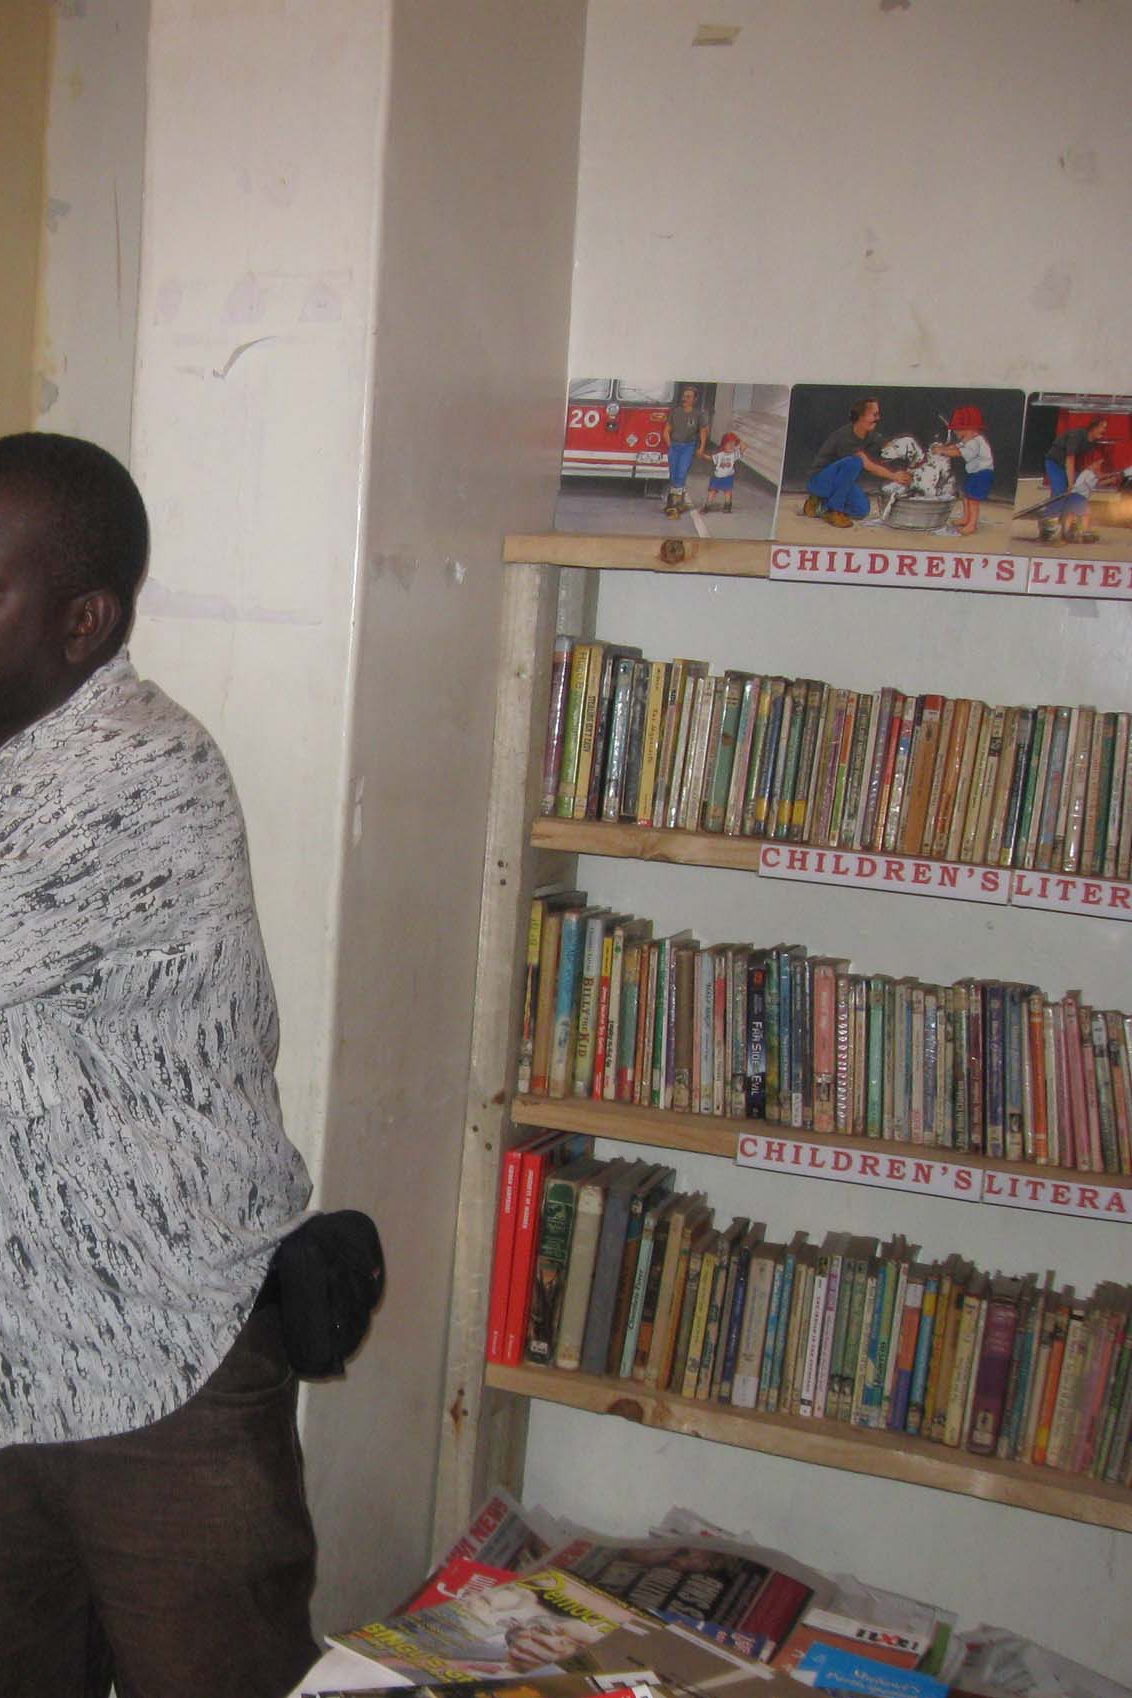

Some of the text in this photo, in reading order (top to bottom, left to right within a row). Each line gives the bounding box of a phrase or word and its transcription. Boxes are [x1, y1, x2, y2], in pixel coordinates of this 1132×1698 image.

[569, 409, 600, 429] 20
[771, 549, 1132, 588] CHILDREN'S LITE
[761, 847, 1132, 910] CHILDREN'S LITER
[580, 977, 595, 1016] BILLY
[577, 1032, 590, 1058] KID
[751, 1021, 763, 1096] FAR SIDE EVIL
[739, 1136, 1127, 1214] CHILDREN'S LITERA
